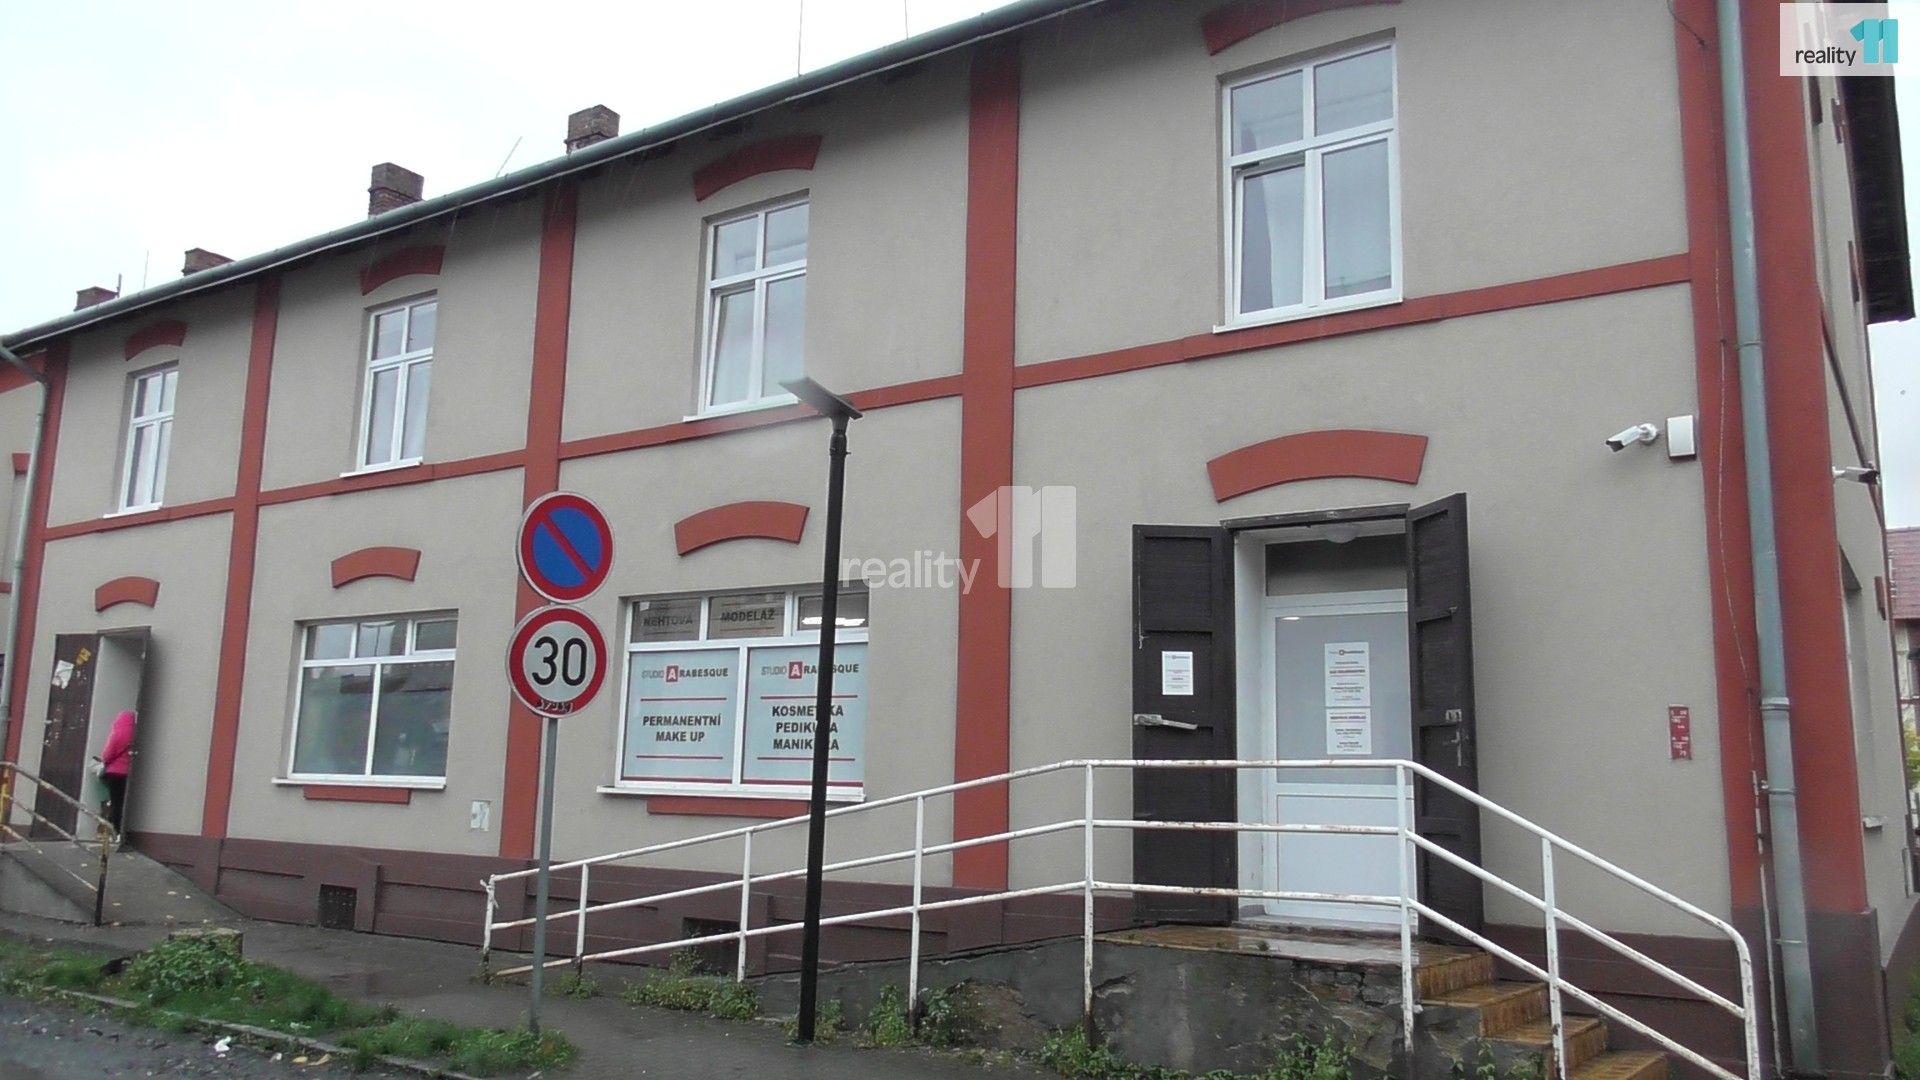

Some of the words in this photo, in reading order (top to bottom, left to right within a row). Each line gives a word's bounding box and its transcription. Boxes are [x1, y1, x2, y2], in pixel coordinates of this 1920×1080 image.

[531, 635, 588, 687] 30
[761, 665, 787, 676] STUDIO
[642, 713, 722, 727] PERMANENTNÍ
[655, 731, 687, 743] MAKE
[689, 731, 706, 742] UP
[773, 738, 840, 751] MANIKA
